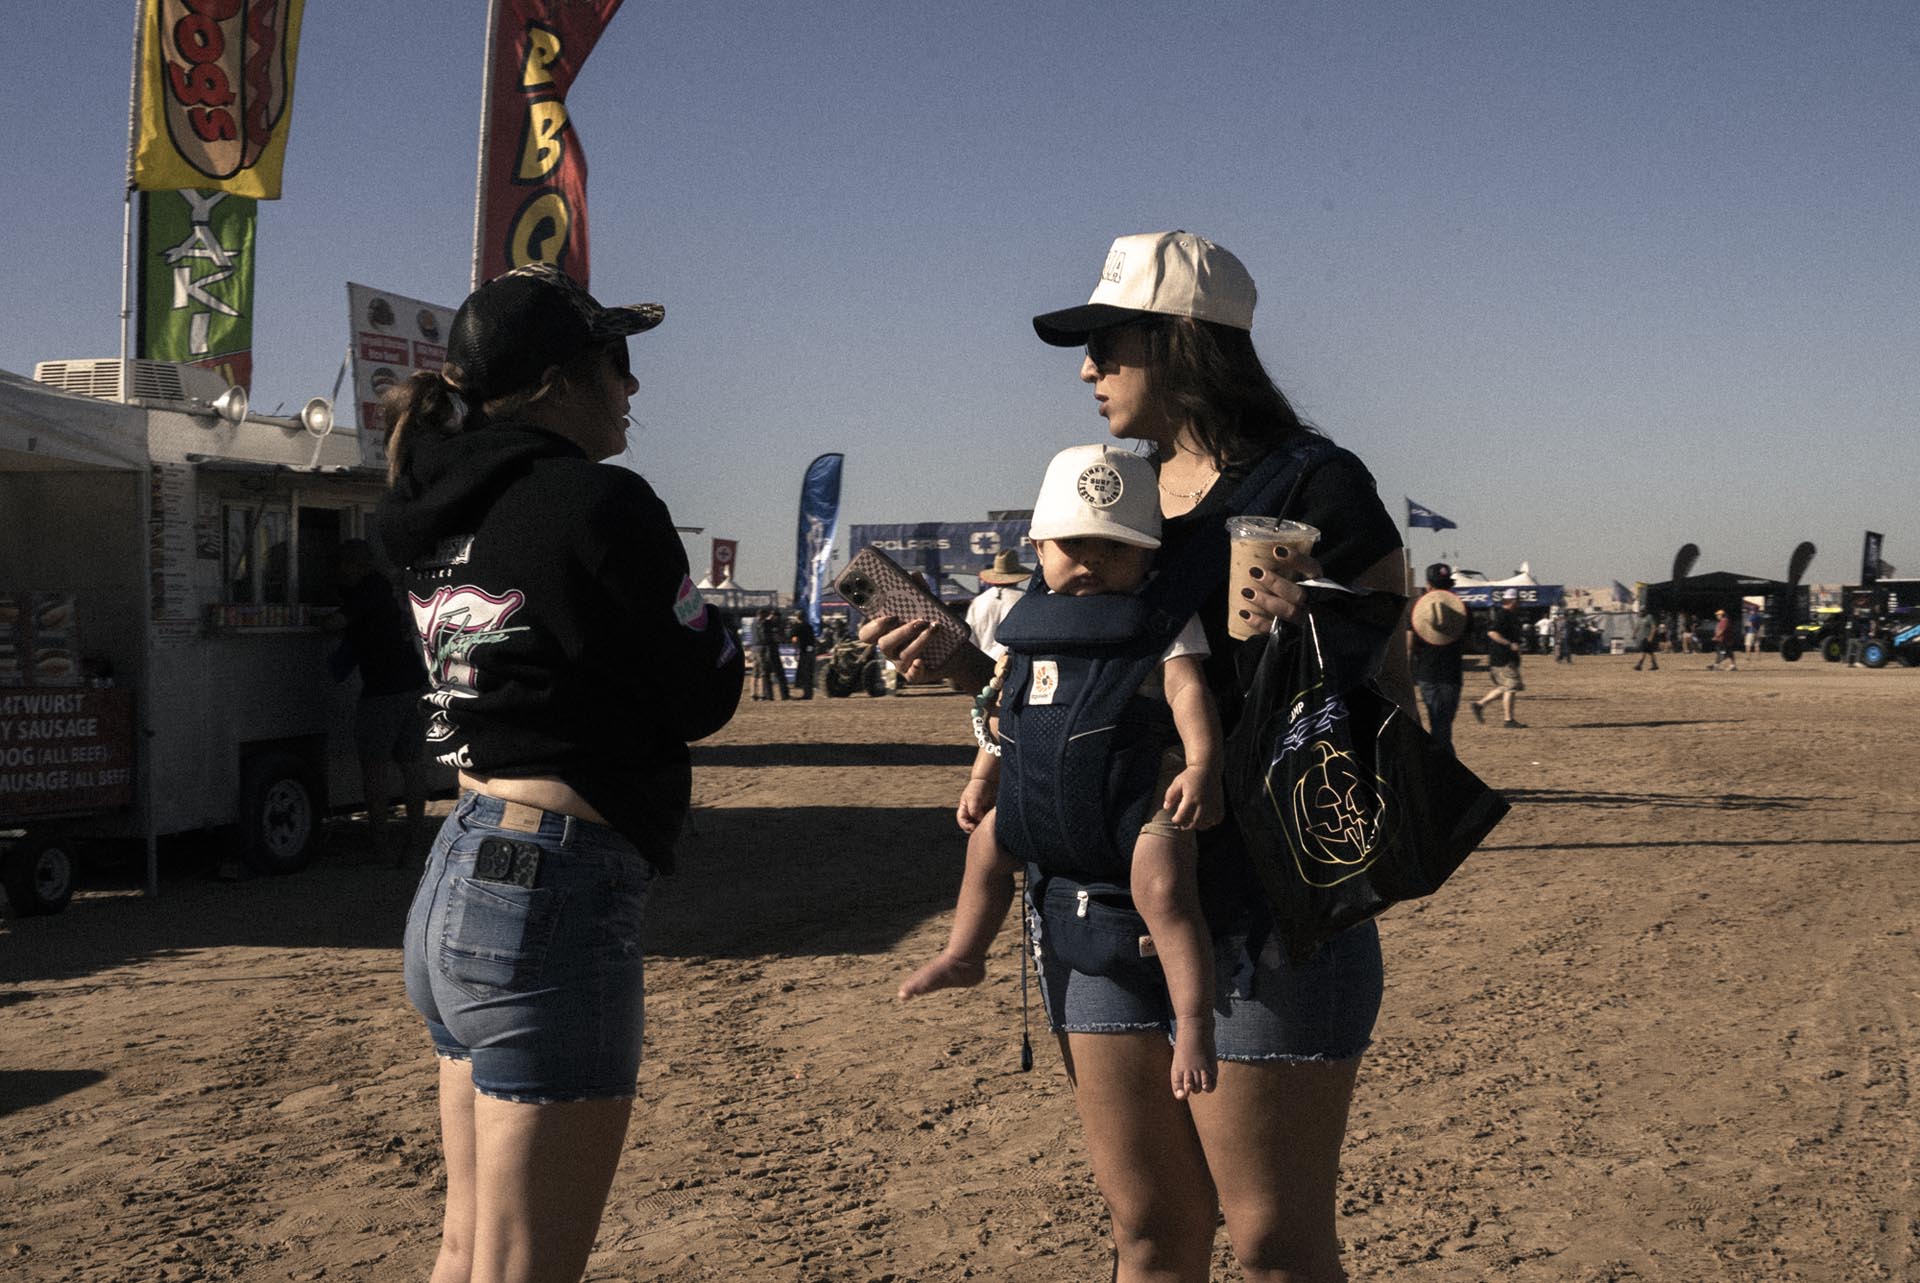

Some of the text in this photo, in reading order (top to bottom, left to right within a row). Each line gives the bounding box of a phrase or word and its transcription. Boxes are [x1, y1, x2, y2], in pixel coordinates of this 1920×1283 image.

[1082, 467, 1105, 481] BINKY
[871, 539, 951, 551] POLARIS
[1492, 590, 1538, 602] SRE
[0, 694, 83, 714] ATWURST
[17, 718, 97, 740] SAUSAGE
